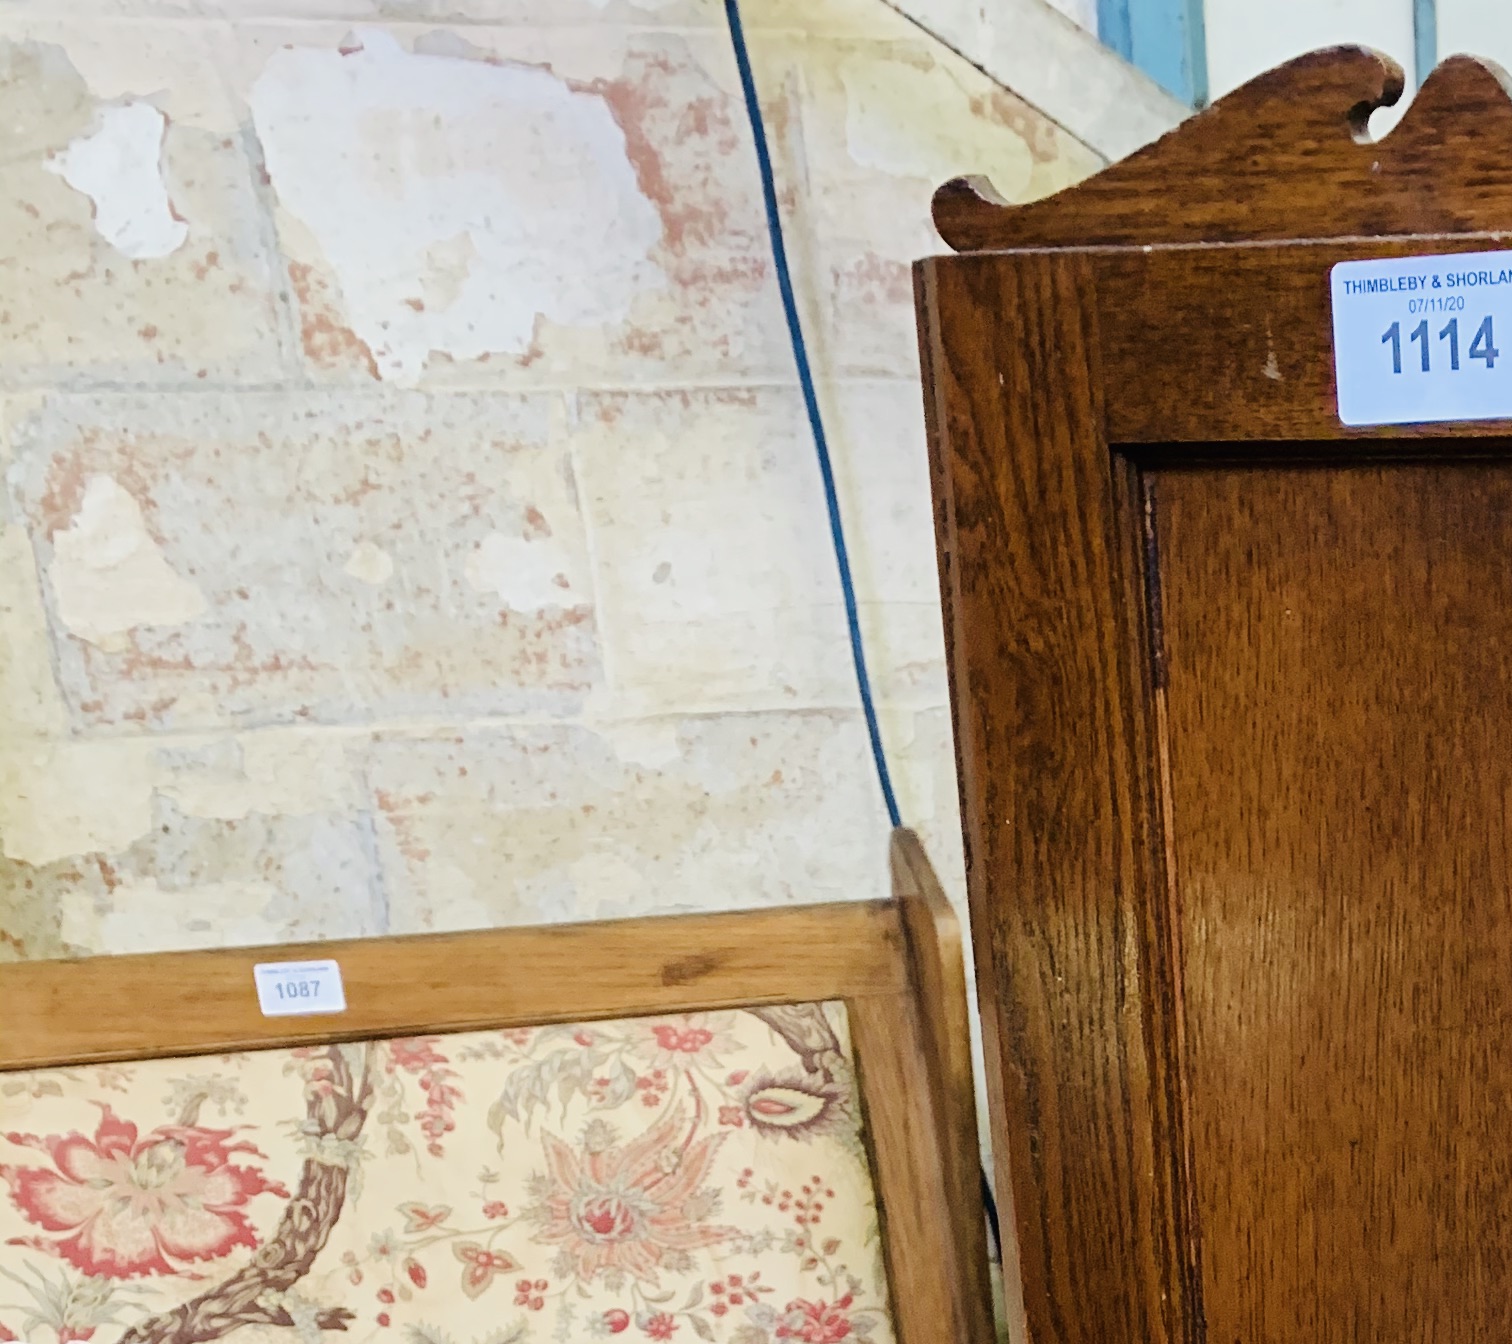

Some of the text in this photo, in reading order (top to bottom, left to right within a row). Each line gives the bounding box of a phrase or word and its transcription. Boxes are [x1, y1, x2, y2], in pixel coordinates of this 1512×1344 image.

[1343, 275, 1427, 295] THIMBLEBY
[1431, 274, 1442, 289] &
[1408, 296, 1465, 314] 07/11/20
[1381, 315, 1500, 374] 1114
[275, 980, 321, 999] 1087
